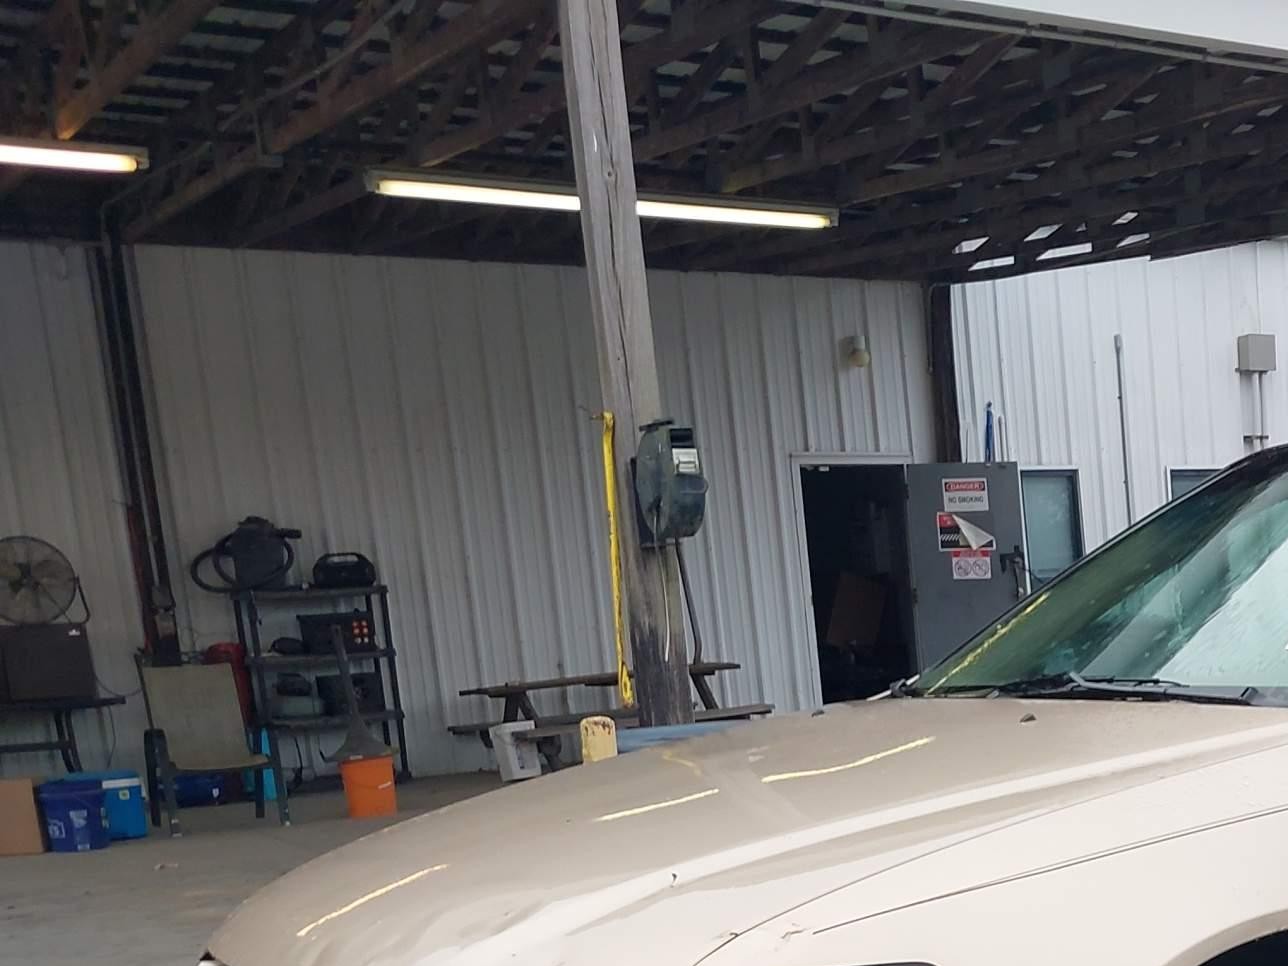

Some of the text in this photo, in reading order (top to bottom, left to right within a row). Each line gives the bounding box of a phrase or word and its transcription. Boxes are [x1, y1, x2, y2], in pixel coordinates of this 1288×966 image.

[950, 482, 980, 490] DANGER
[948, 495, 984, 504] NO SMOKING
